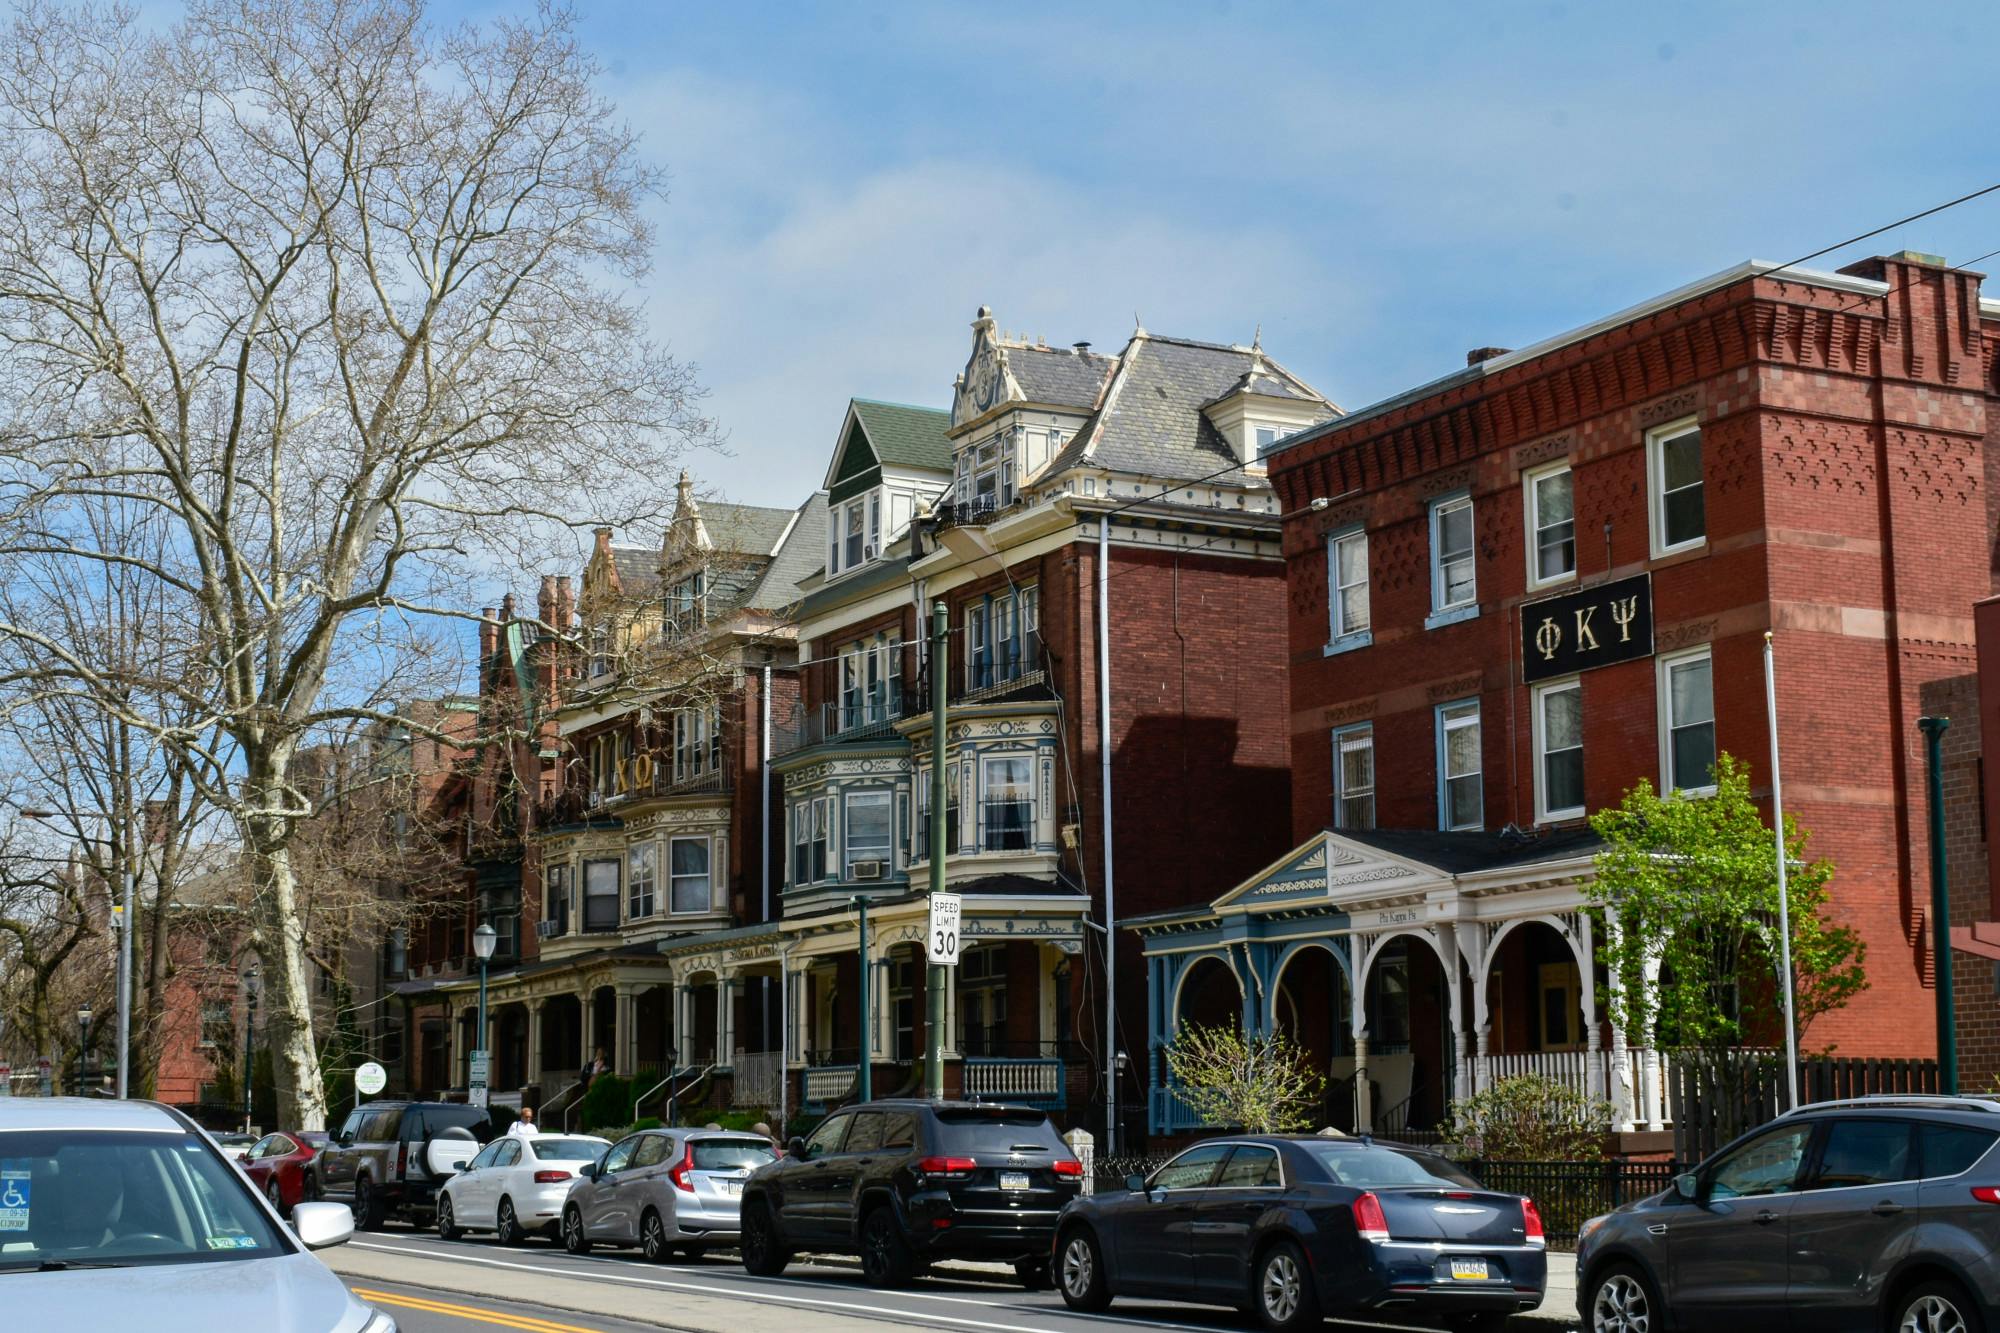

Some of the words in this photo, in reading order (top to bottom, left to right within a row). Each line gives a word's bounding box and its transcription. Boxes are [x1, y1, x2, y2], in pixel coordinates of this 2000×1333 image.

[934, 901, 959, 913] SPEED
[936, 916, 955, 927] LIMIT
[1379, 911, 1389, 924] Phi
[1390, 911, 1407, 924] Kappa
[1408, 907, 1417, 921] Psi
[934, 930, 956, 956] 30
